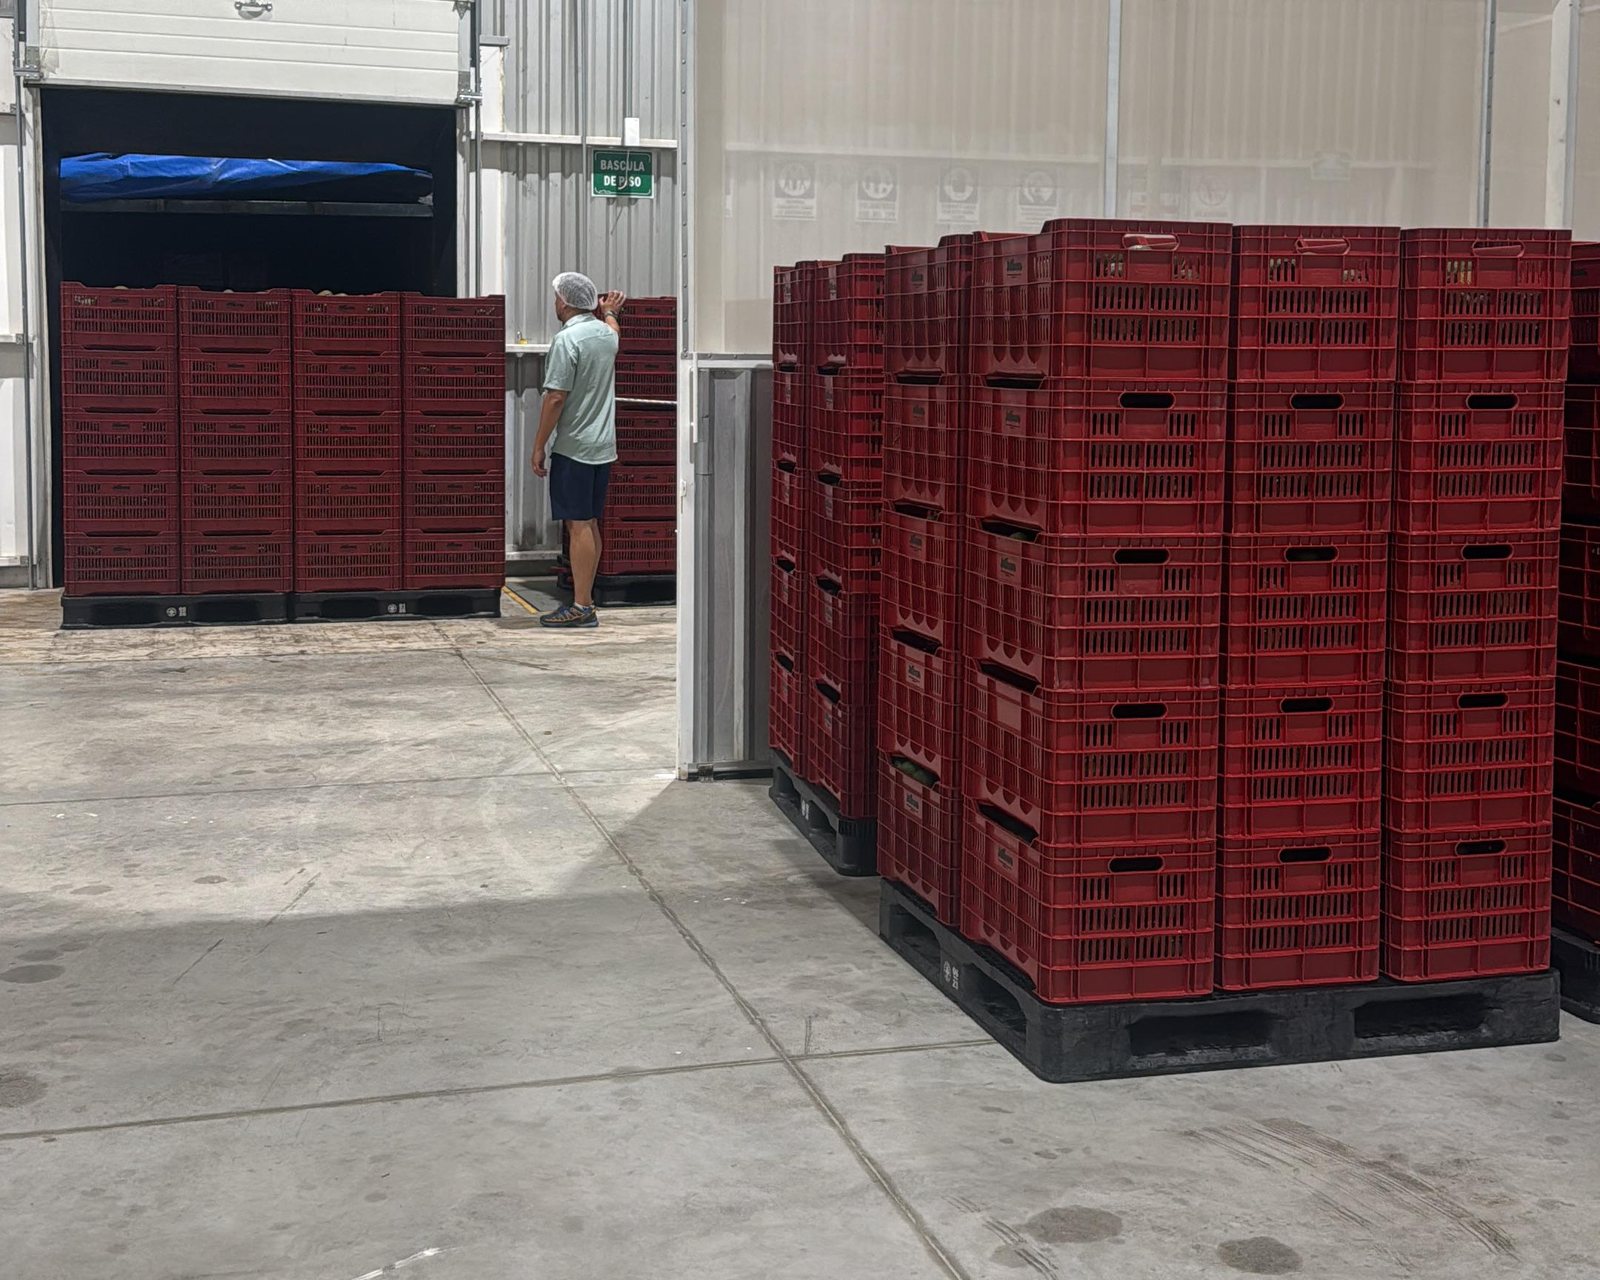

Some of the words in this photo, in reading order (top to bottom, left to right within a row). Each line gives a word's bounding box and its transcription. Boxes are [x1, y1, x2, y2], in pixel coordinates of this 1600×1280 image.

[600, 160, 645, 171] BASCULA
[603, 175, 617, 186] DE
[618, 176, 641, 187] PSO
